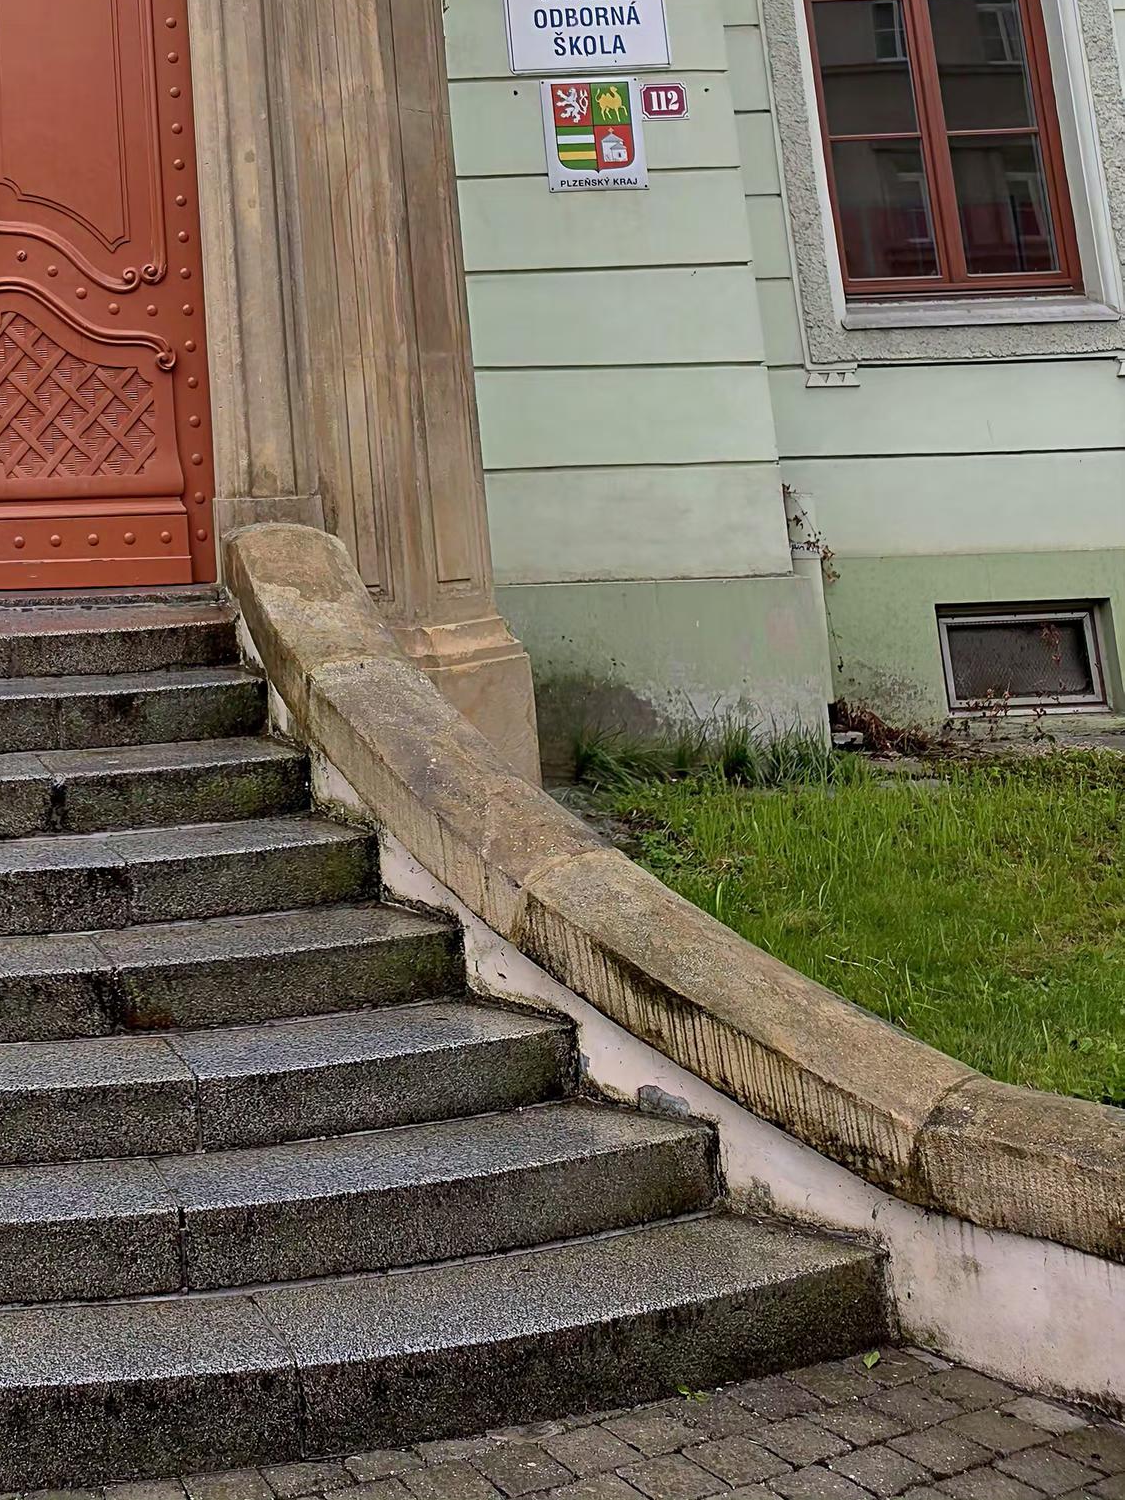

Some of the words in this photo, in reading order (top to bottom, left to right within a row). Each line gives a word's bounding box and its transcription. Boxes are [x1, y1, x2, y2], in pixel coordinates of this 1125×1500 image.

[533, 1, 641, 29] ODBORNÁ
[553, 31, 626, 56] ŠKOLA
[650, 90, 679, 112] 112
[560, 177, 610, 188] PLZEŇSKÝ
[613, 177, 638, 186] KRAJ
